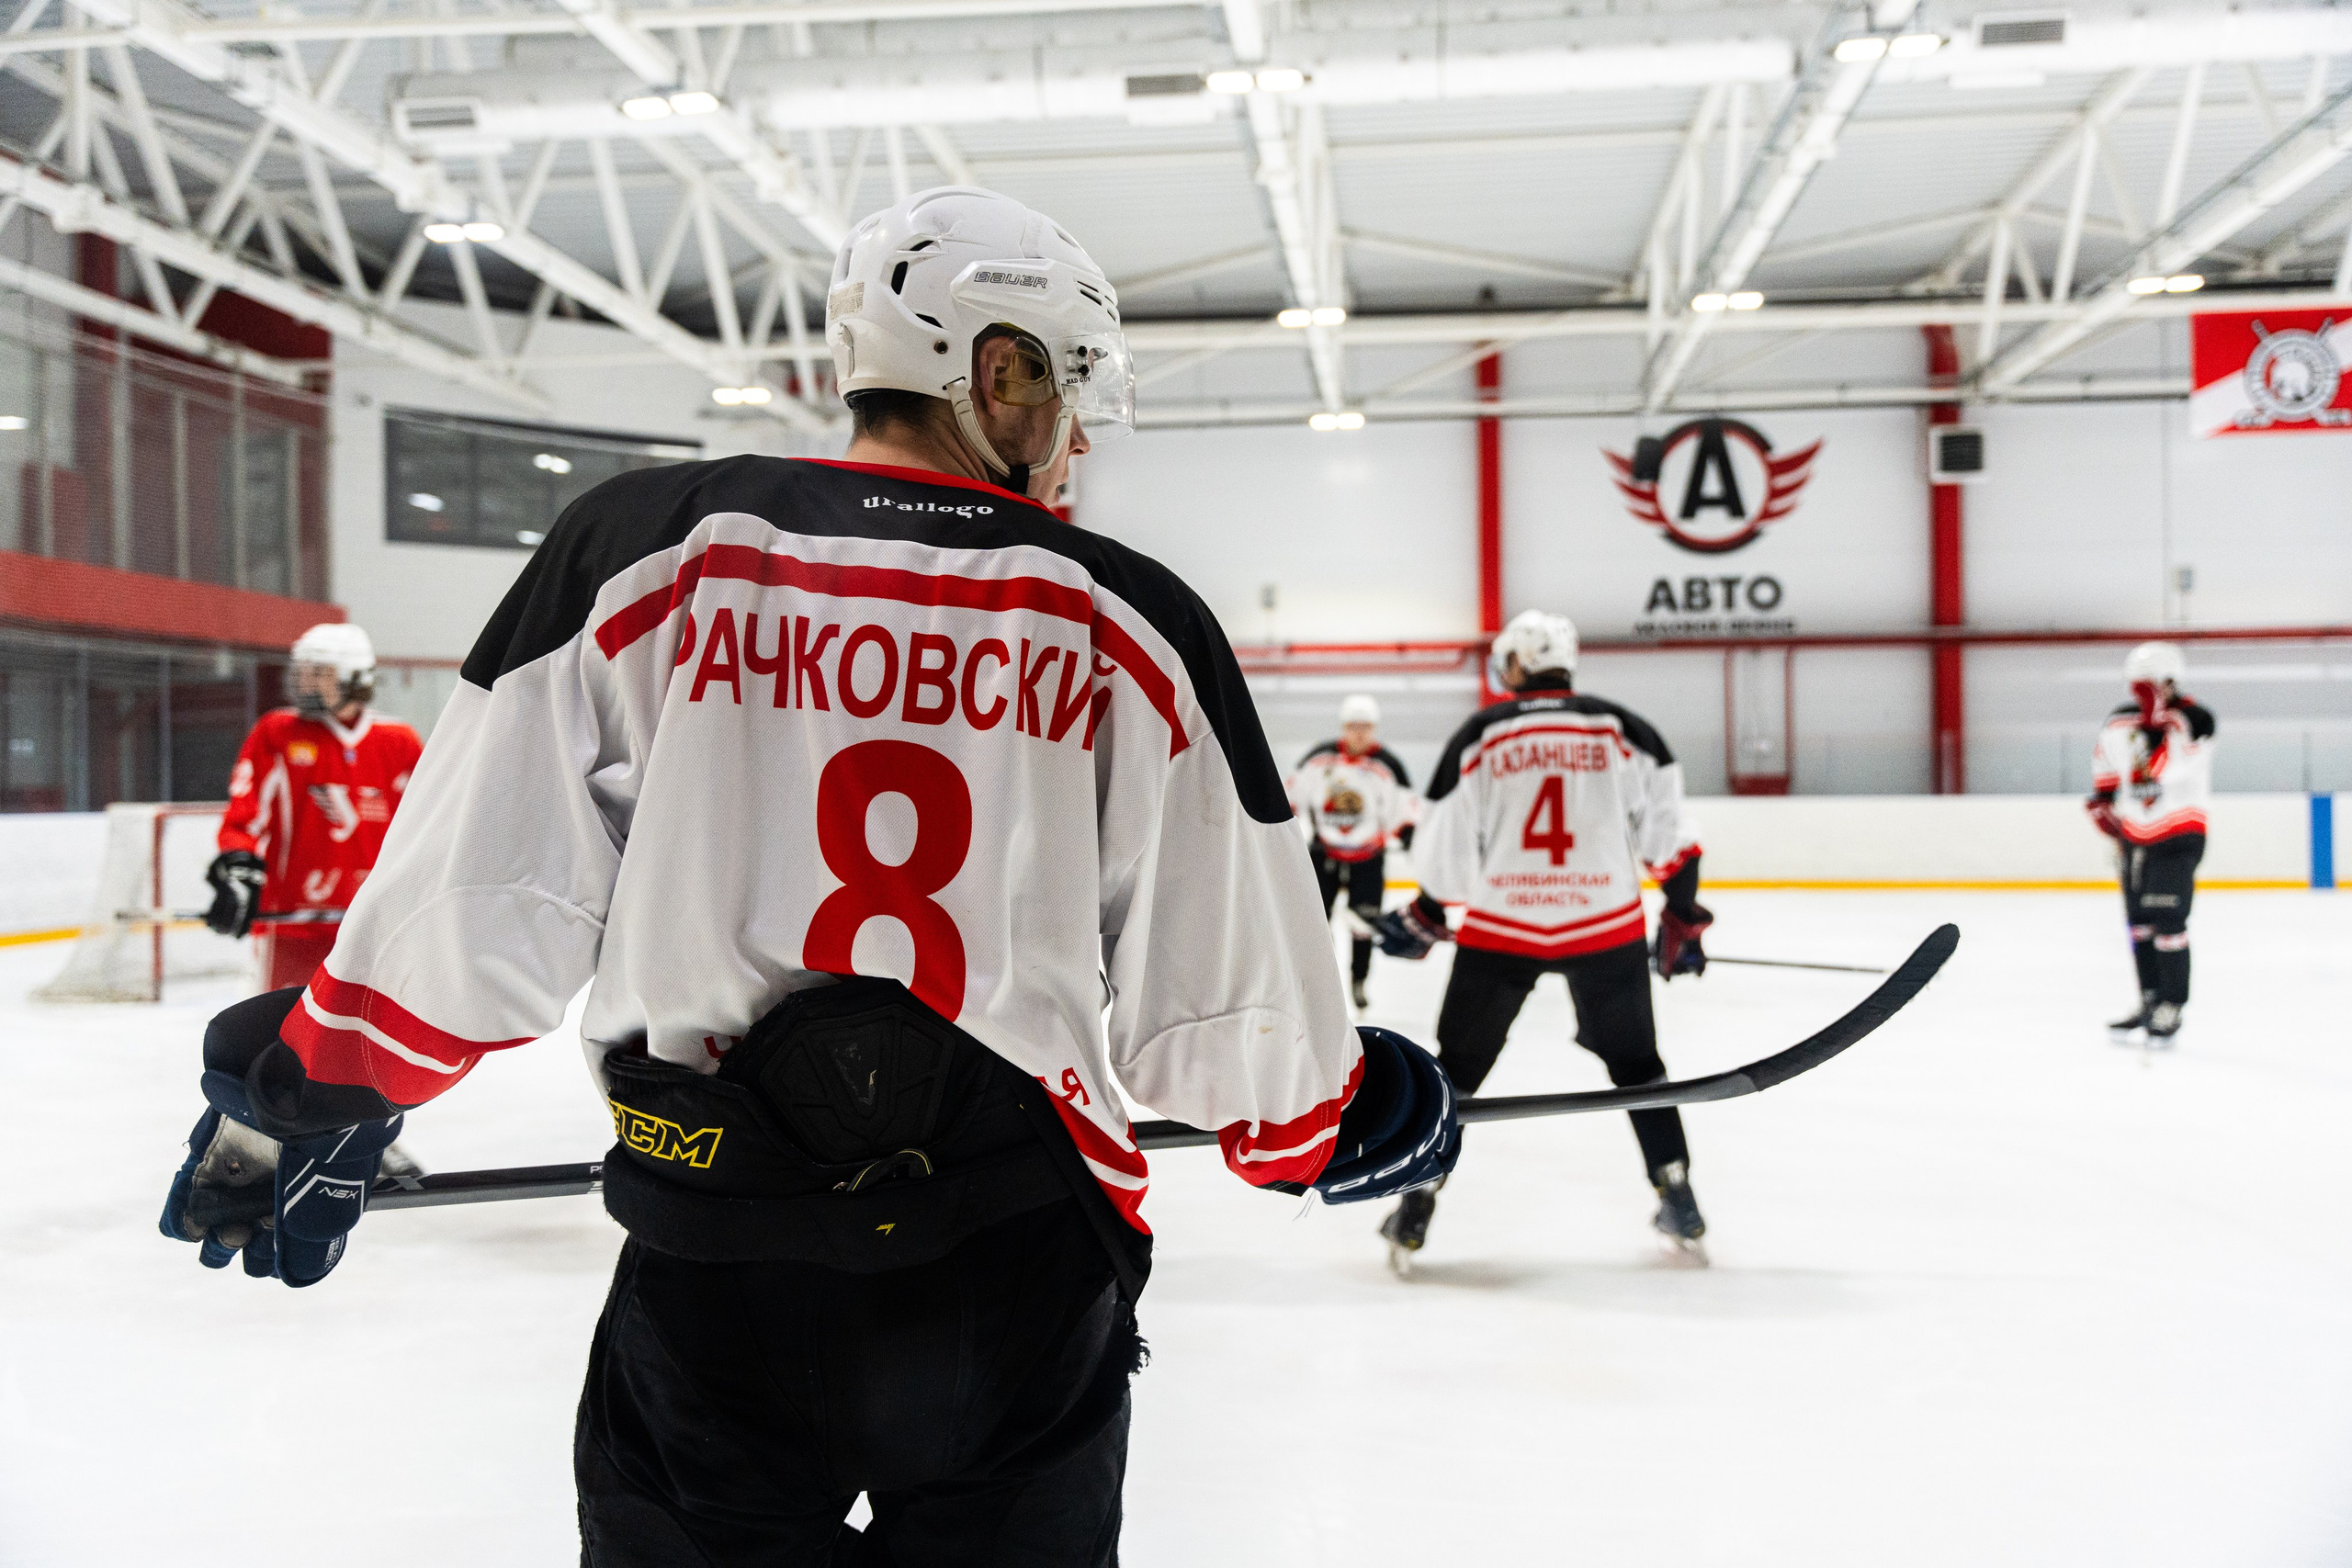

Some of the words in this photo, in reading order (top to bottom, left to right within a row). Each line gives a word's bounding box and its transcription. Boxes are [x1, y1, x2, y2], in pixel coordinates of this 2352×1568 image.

[974, 271, 1048, 289] BAUER
[863, 496, 994, 519] urallogo
[1645, 575, 1783, 613] АВТО
[1521, 775, 1575, 867] 4
[803, 739, 973, 1023] 8
